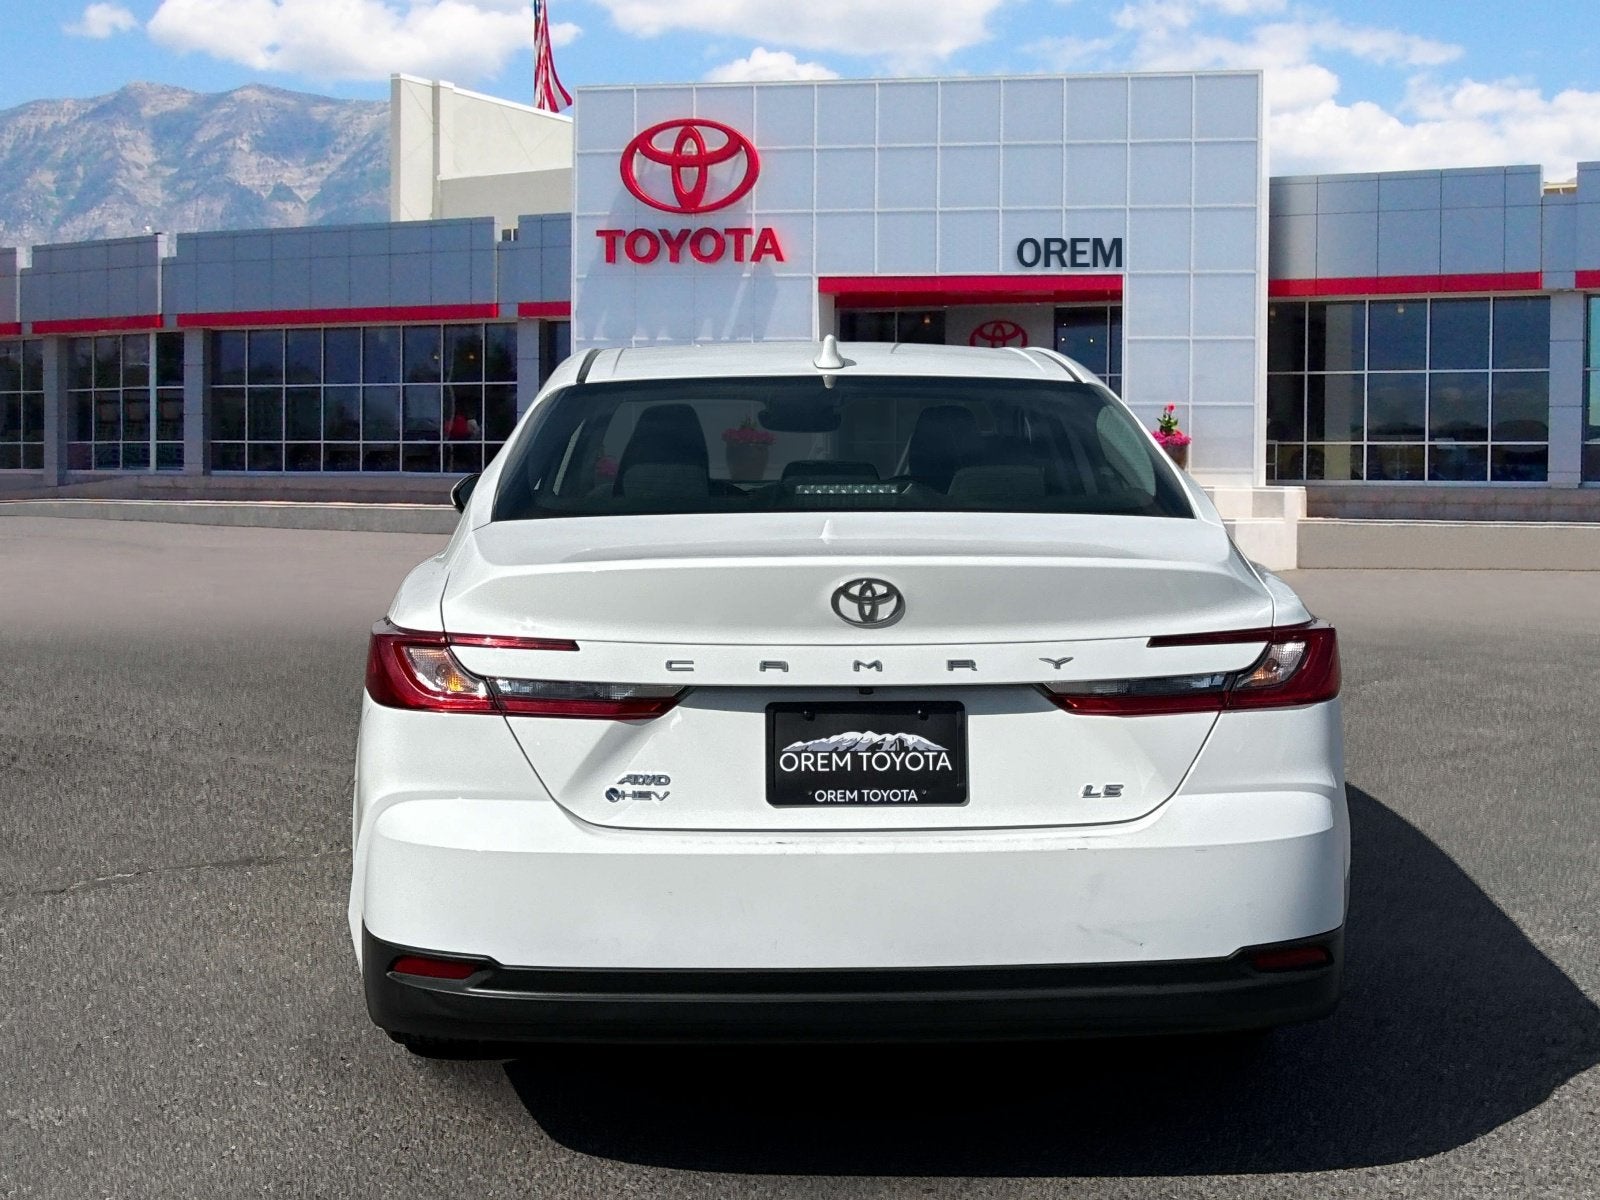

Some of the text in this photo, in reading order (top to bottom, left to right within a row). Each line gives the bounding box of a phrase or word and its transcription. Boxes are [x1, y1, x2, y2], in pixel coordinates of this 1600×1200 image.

[596, 227, 785, 264] TOYOTA
[1017, 237, 1123, 268] OREM
[665, 655, 1074, 673] CAMRY
[779, 751, 952, 772] OREM TOYOTA
[617, 774, 671, 786] AWD
[814, 789, 918, 802] OREM TOYOTA
[1082, 784, 1124, 798] LE
